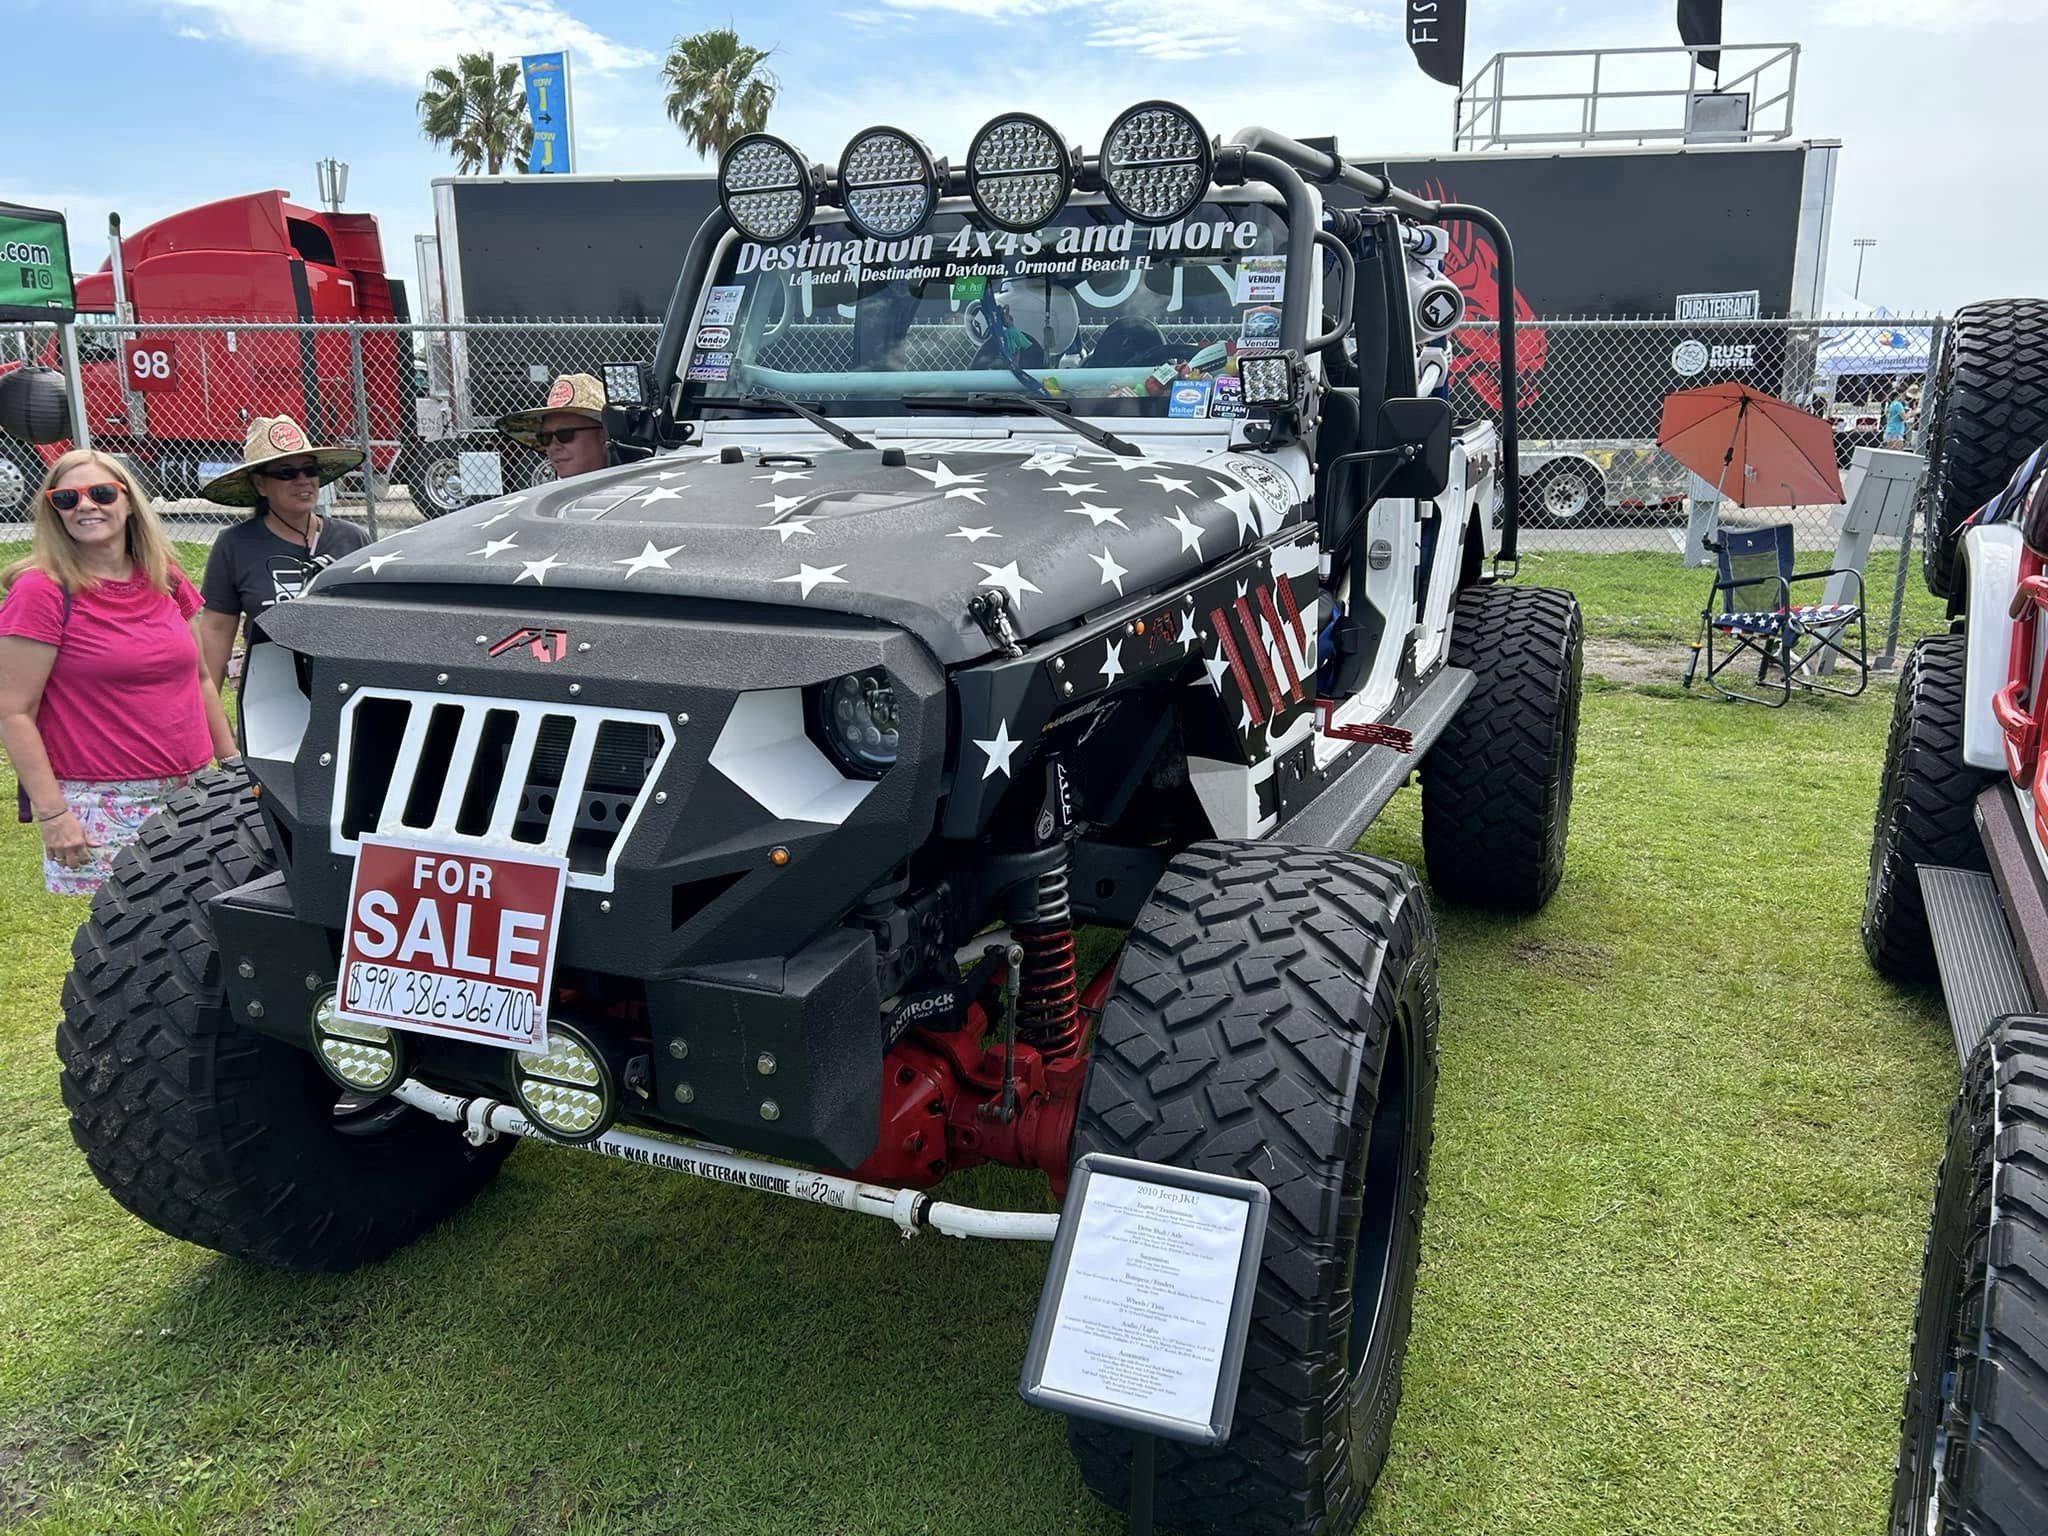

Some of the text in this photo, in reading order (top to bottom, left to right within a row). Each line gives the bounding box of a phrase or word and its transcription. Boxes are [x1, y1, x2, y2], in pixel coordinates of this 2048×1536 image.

[541, 141, 553, 166] J
[0, 241, 50, 265] .com
[735, 217, 1258, 275] Destination 4x4s and More
[789, 255, 1154, 287] Located in Destination Daytona, Ormond Beach FL
[1248, 274, 1281, 284] VENDOR
[1682, 297, 1752, 319] DURATERRAIN
[698, 335, 728, 344] Vendor
[1711, 344, 1755, 359] RUST
[132, 350, 170, 379] 98
[1709, 358, 1754, 368] BUSTER
[413, 856, 493, 899] FOR
[353, 889, 546, 984] SALE
[890, 993, 954, 1038] ANTIROCK
[603, 1142, 622, 1158] THE
[624, 1146, 649, 1164] WAR
[652, 1152, 697, 1174] AGAINST
[699, 1161, 747, 1185] VETERAN
[749, 1172, 791, 1195] SUICIDE
[1136, 1185, 1199, 1206] 2010 Jeep JKU
